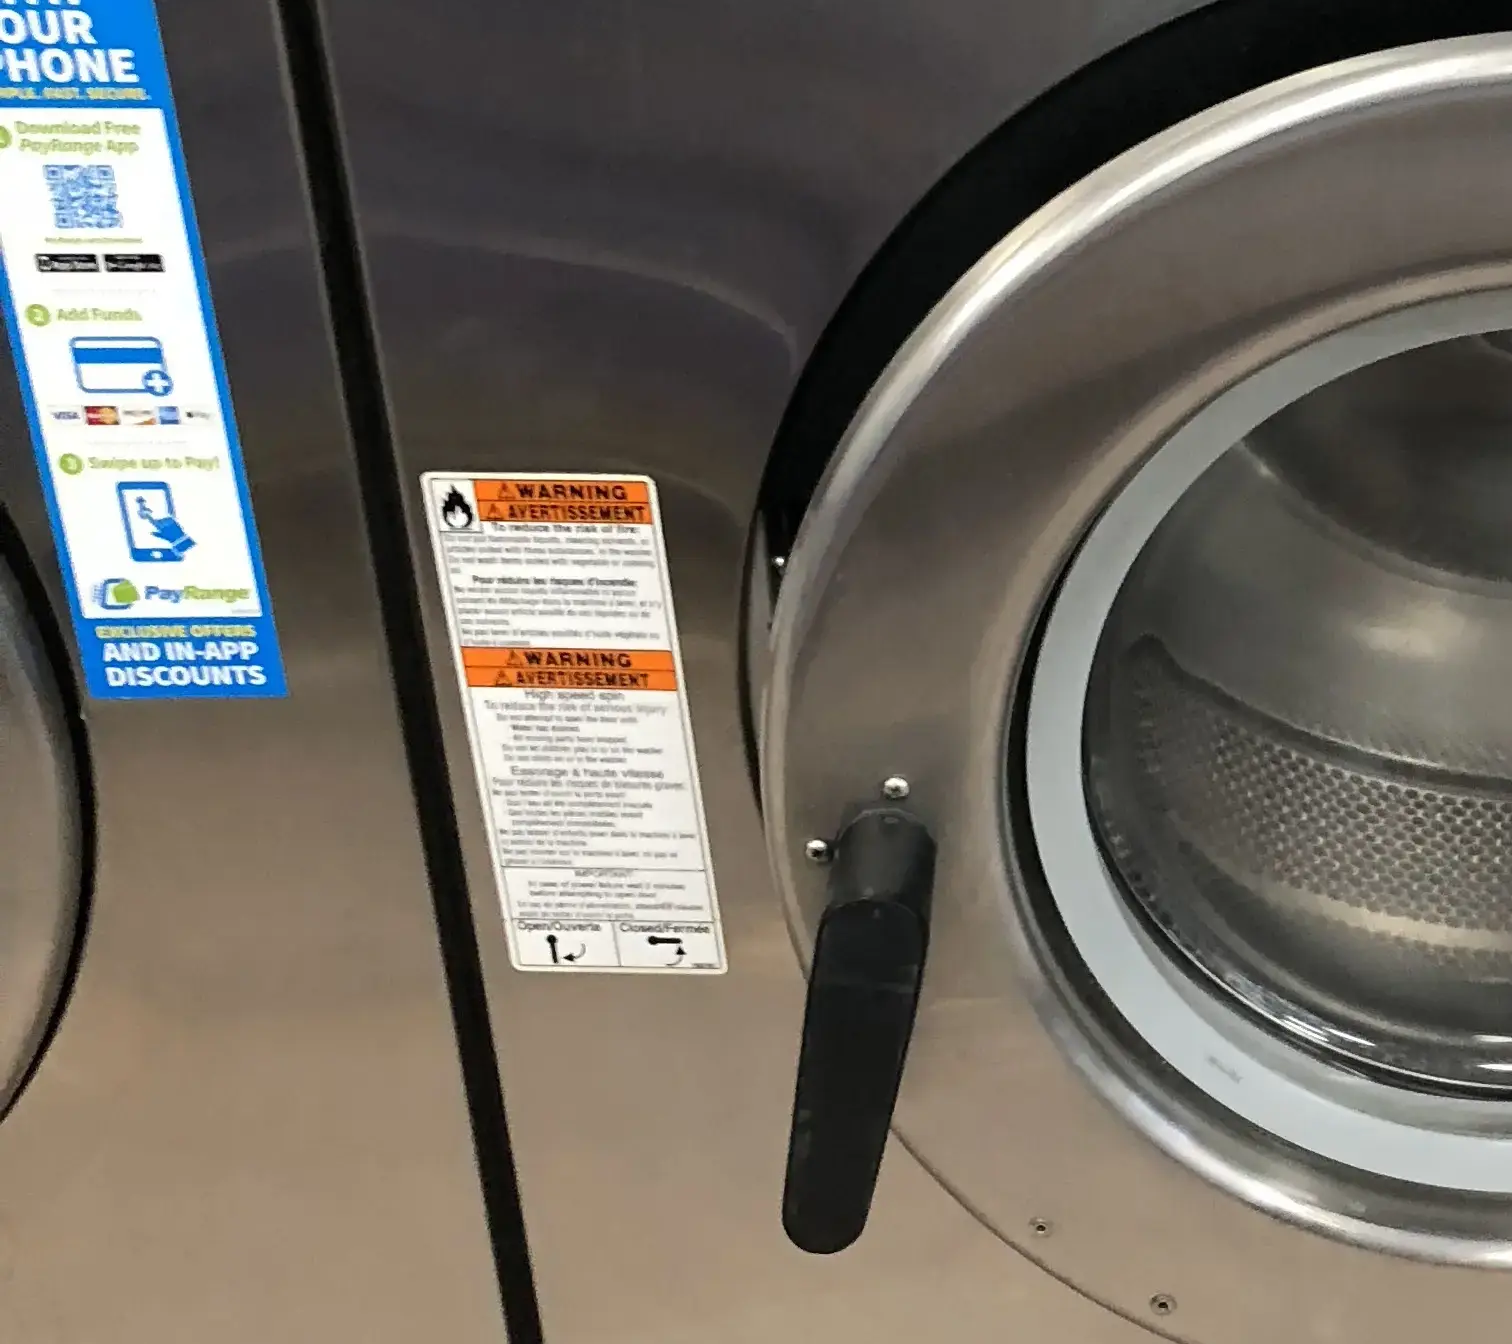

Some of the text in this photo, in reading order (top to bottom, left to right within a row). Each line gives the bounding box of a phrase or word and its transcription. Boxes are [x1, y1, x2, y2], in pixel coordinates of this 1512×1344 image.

[0, 48, 140, 83] HONE
[57, 309, 89, 321] Add
[91, 308, 143, 322] Funds
[515, 483, 628, 501] WARNING
[508, 503, 645, 521] AVERTISSEMENT
[145, 585, 252, 604] PayRange
[103, 642, 260, 662] AND IN-APP
[523, 652, 632, 668] WARNING
[104, 665, 267, 686] DISCOUNTS
[516, 670, 648, 687] AVERTISSEMENT
